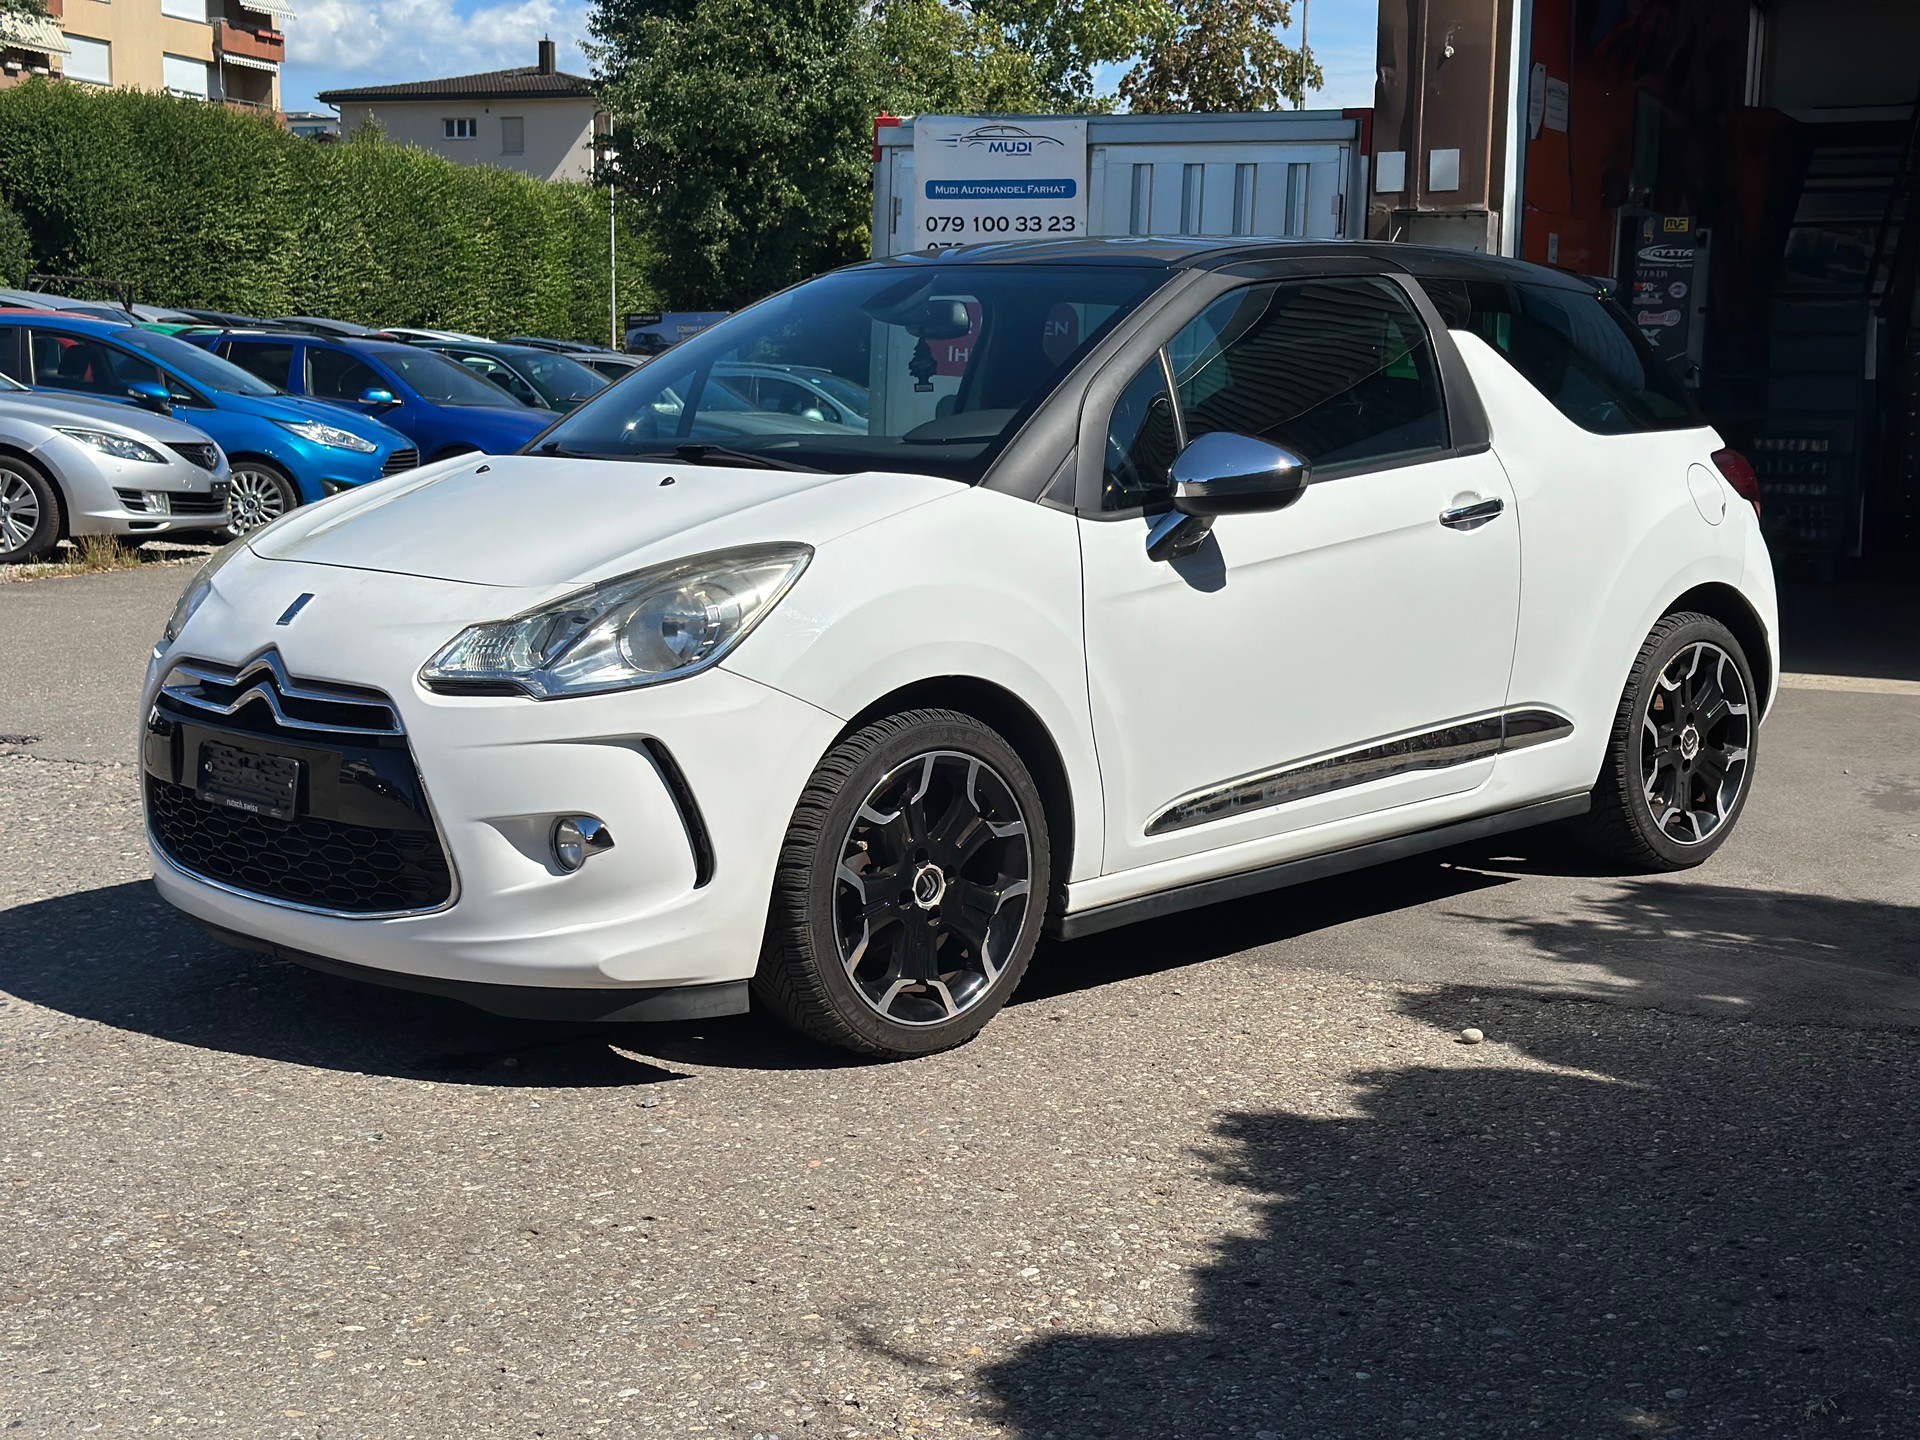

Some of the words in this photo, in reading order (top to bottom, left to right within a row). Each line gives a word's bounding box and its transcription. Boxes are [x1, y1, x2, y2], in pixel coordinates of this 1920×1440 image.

[988, 142, 1032, 153] MUDI
[926, 216, 965, 232] 079
[973, 216, 1010, 232] 100
[1015, 216, 1043, 232] 33
[1047, 216, 1076, 232] 23
